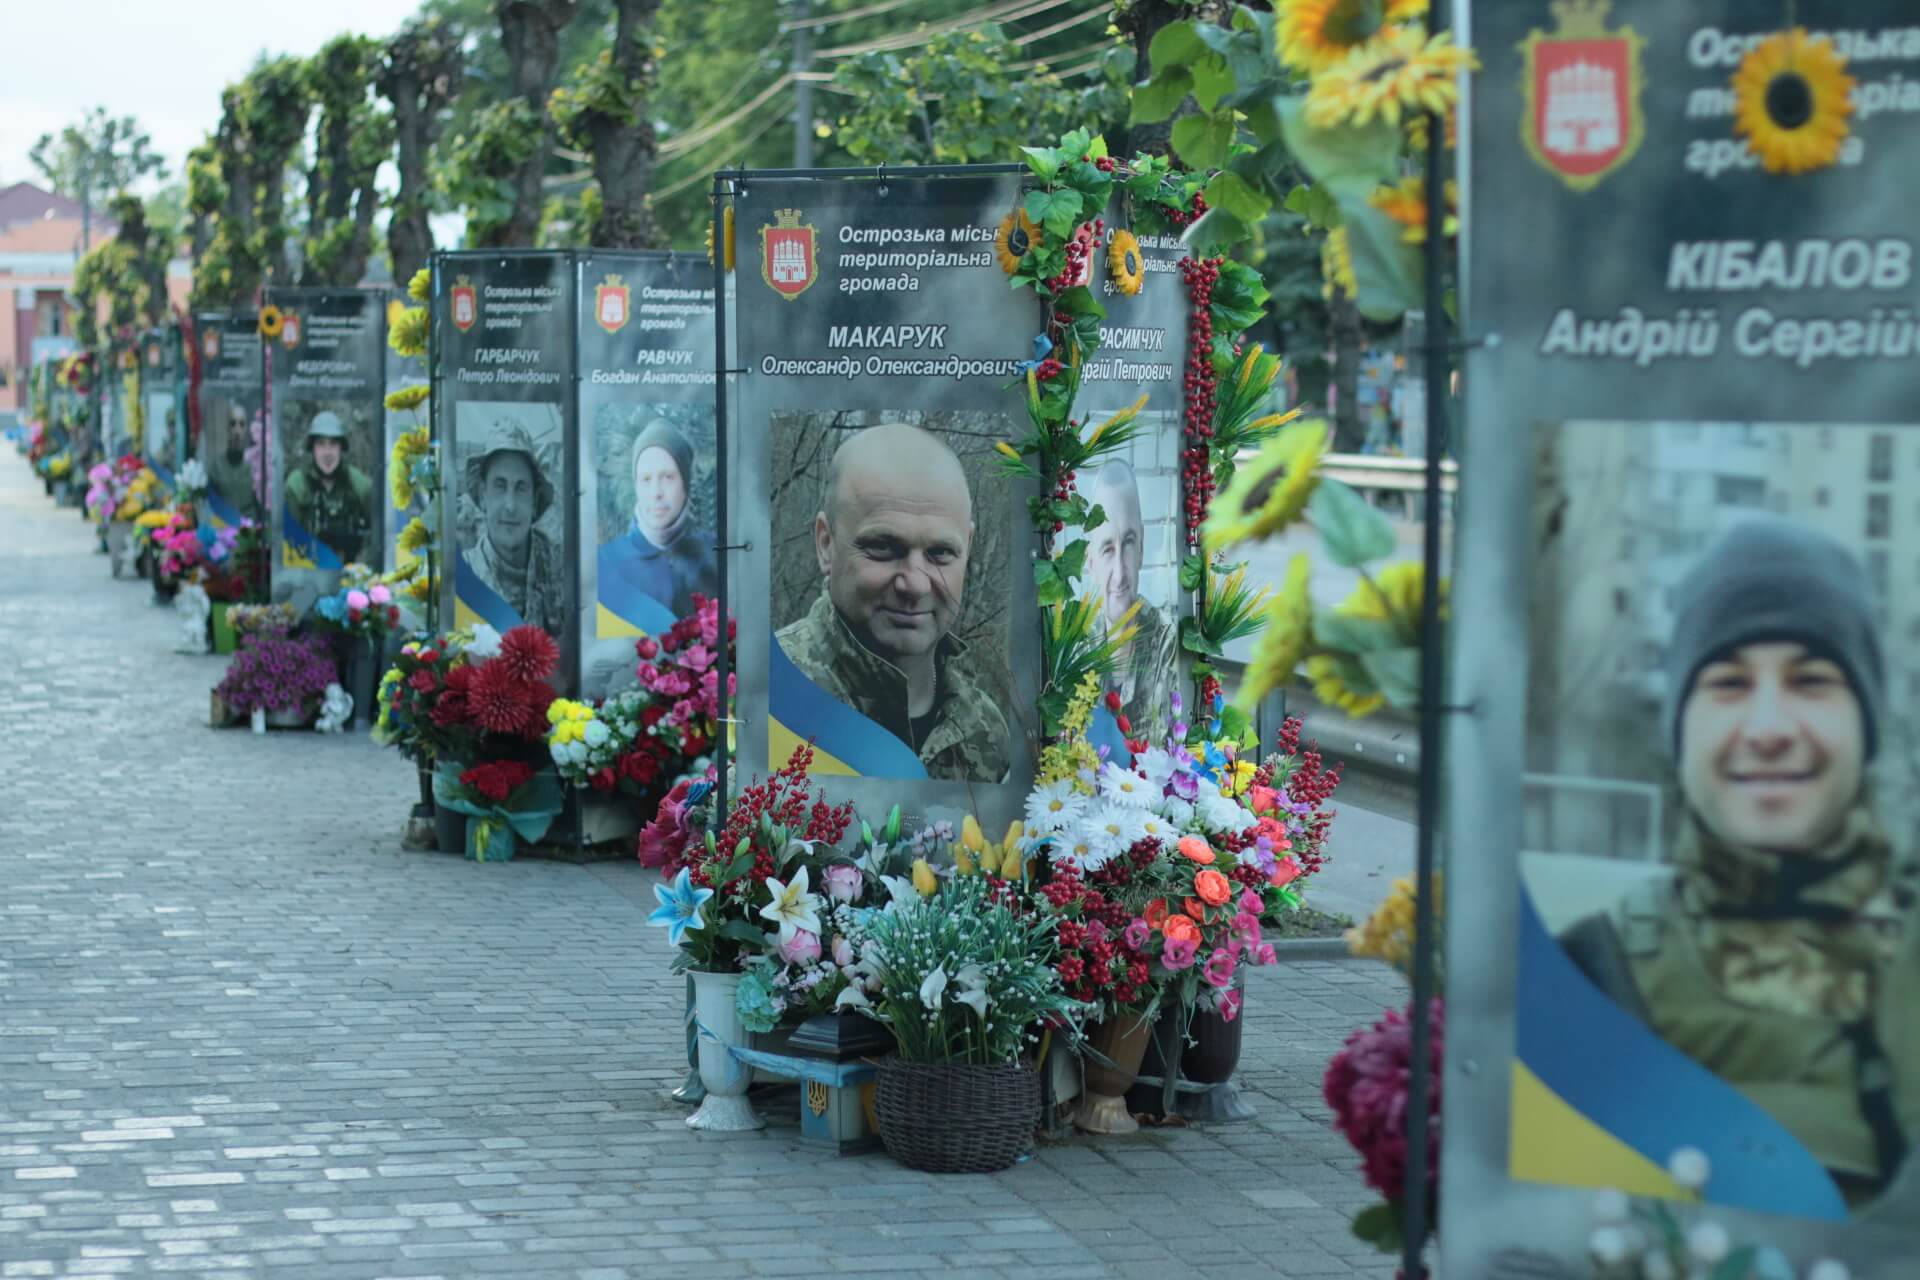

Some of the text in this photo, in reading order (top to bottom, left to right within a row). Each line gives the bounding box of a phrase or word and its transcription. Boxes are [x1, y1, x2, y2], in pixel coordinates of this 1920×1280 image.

[1689, 27, 1920, 67] Осзька
[839, 226, 945, 246] Острозька
[1106, 228, 1158, 249] Озька
[839, 250, 991, 270] територіальна
[1666, 240, 1912, 289] КІБАЛОВ
[839, 273, 919, 294] громада
[640, 317, 686, 331] громада
[828, 326, 946, 348] МАКАРУК
[1097, 327, 1165, 350] РАСИМЧУК
[1541, 307, 1920, 367] Андрій Сергій
[475, 348, 541, 363] ГАРБАРЧУК
[637, 350, 693, 364] РАВЧУК
[458, 367, 494, 384] Петро
[591, 369, 639, 385] Богдан
[762, 356, 1020, 379] Олександр Олександрович
[1081, 359, 1172, 384] ргій Петрович
